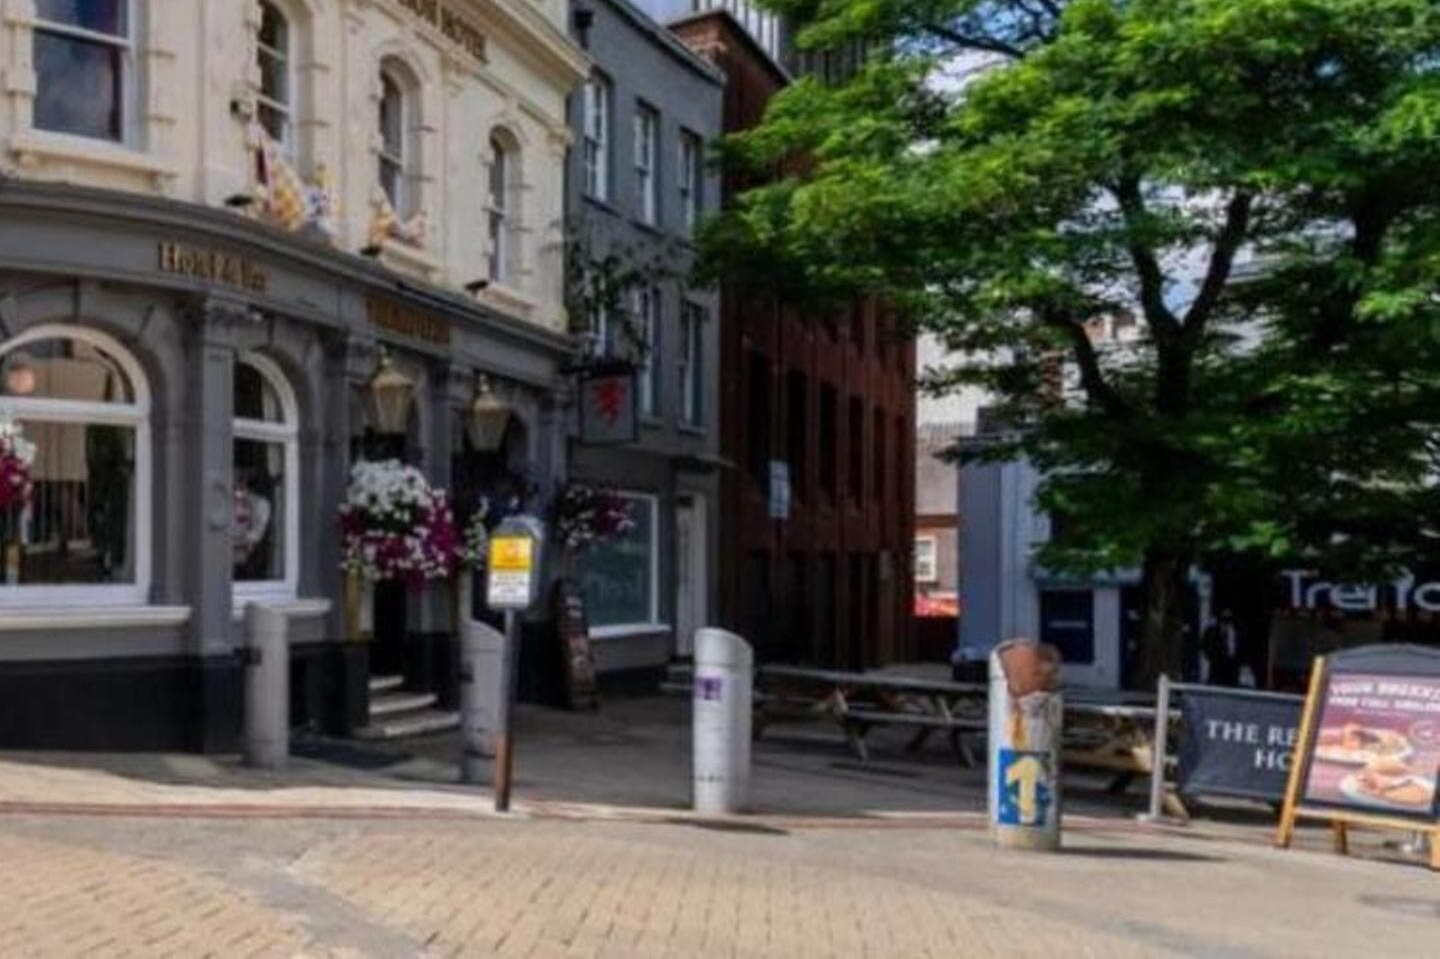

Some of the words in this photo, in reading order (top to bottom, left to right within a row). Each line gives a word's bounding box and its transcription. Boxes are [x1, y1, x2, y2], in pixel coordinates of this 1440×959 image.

[1205, 720, 1259, 743] THE
[1267, 725, 1298, 746] RE
[1254, 749, 1290, 771] HO
